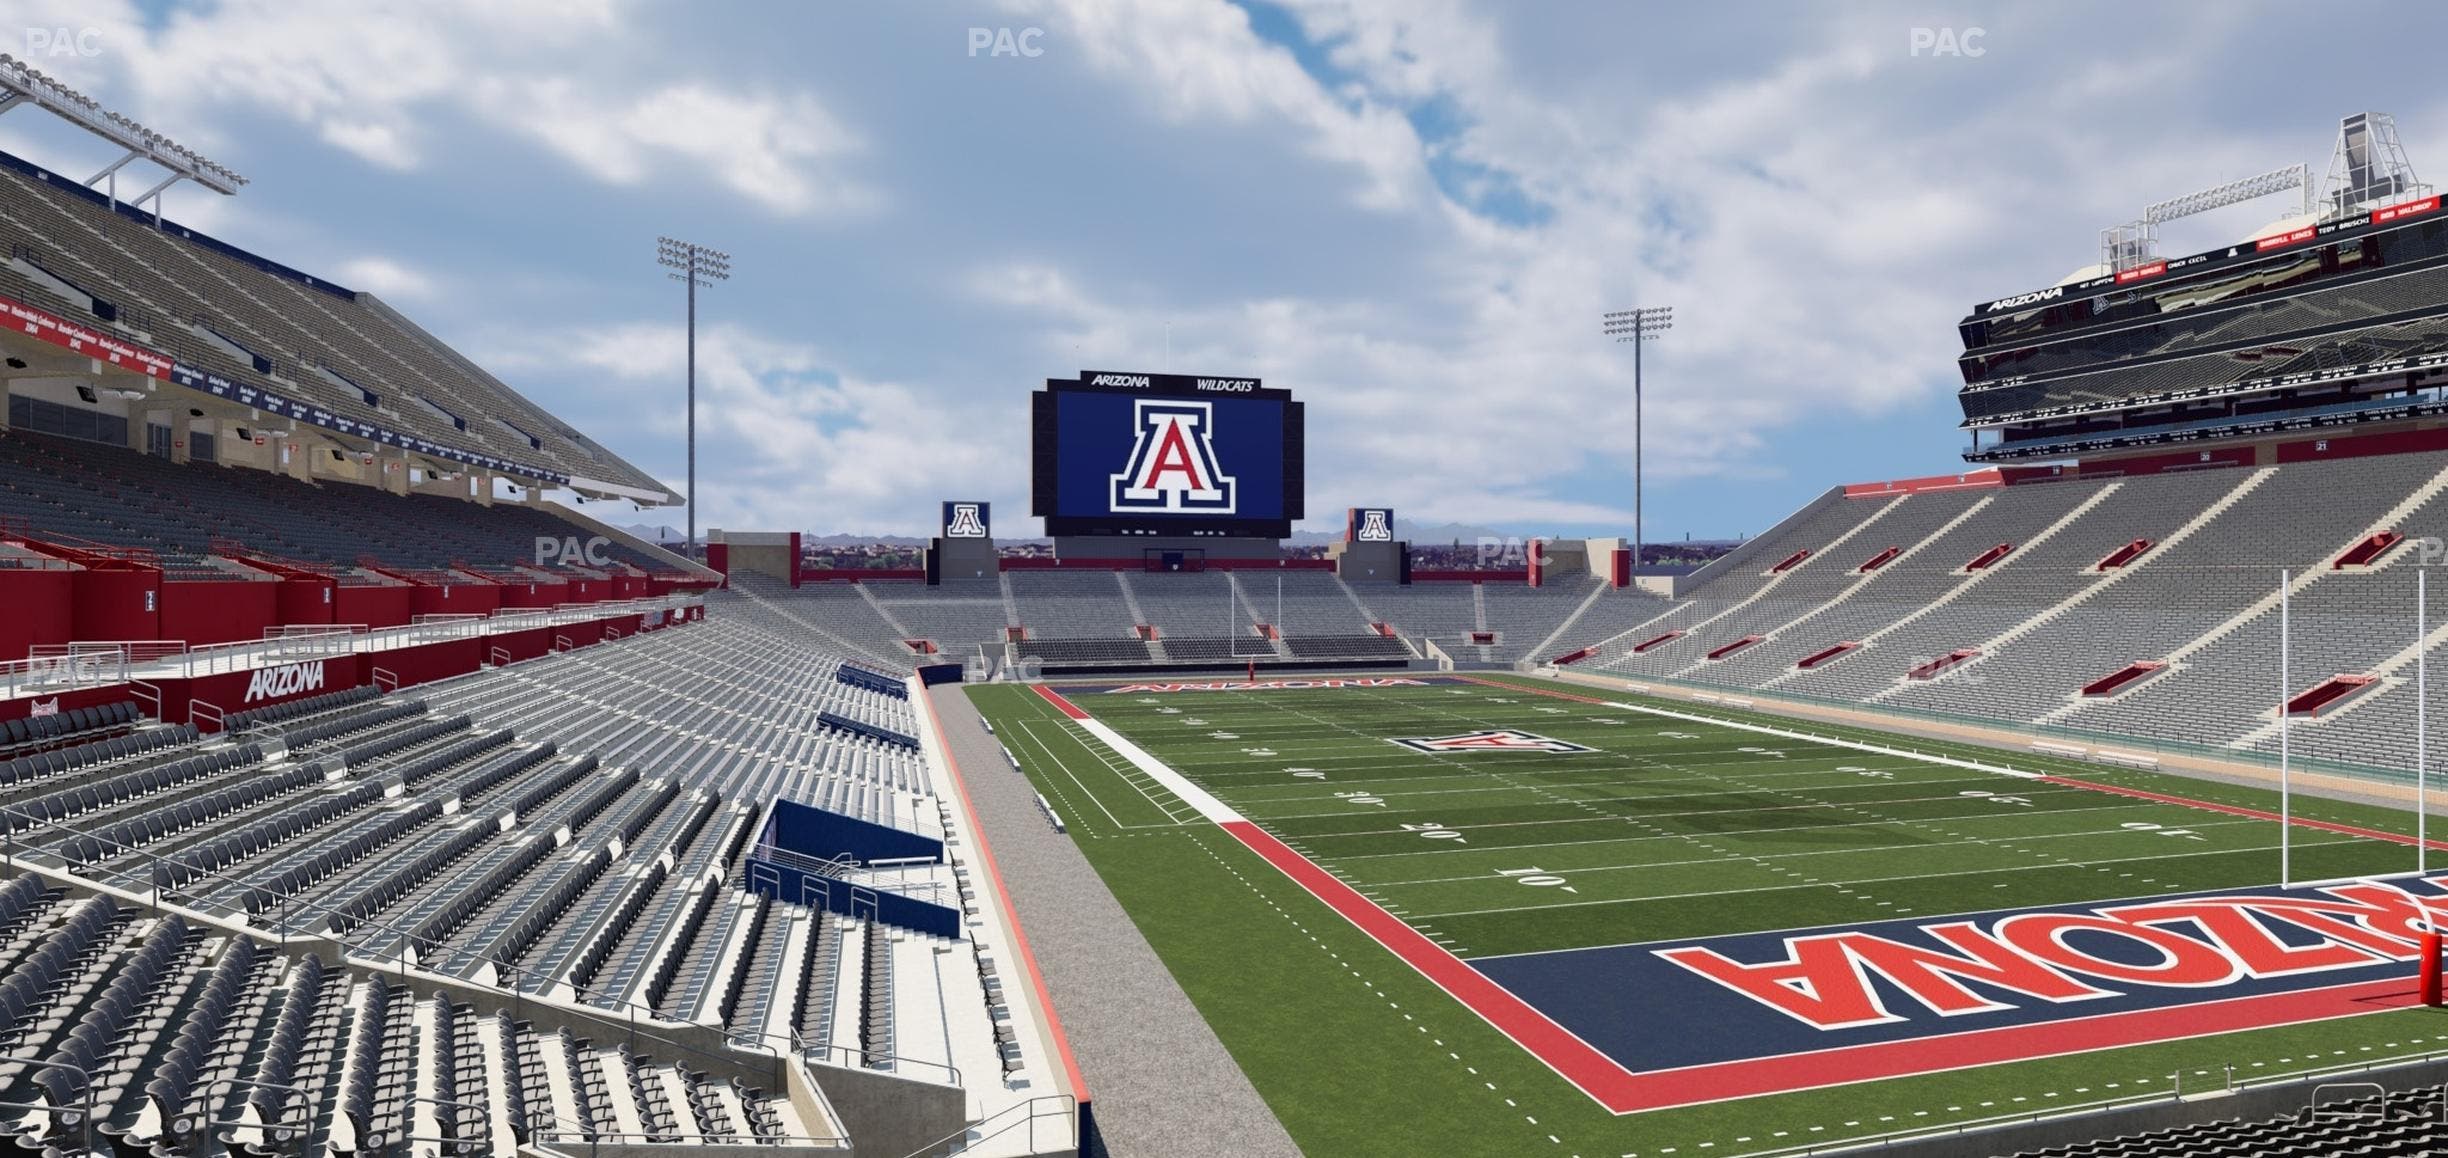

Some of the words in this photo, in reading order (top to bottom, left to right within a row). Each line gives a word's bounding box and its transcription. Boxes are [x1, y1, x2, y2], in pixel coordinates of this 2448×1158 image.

[2318, 225, 2336, 234] TEDY
[2339, 217, 2370, 230] BRUSCHI
[1987, 286, 2063, 312] ARIZONA
[1091, 374, 1150, 389] ARIZONA
[1196, 379, 1255, 393] WILDCATS
[1110, 398, 1237, 515] A
[946, 504, 987, 539] A
[1358, 510, 1391, 542] A
[244, 661, 324, 703] ARIZONA
[1105, 677, 1431, 694] ARIZONA
[1385, 728, 1603, 755] A
[1334, 791, 1384, 804] 30
[1958, 789, 2034, 807] 20
[1400, 822, 1462, 840] 20
[2120, 821, 2204, 842] 10
[1495, 865, 1567, 887] 10
[1651, 875, 2448, 1030] RIZONA
